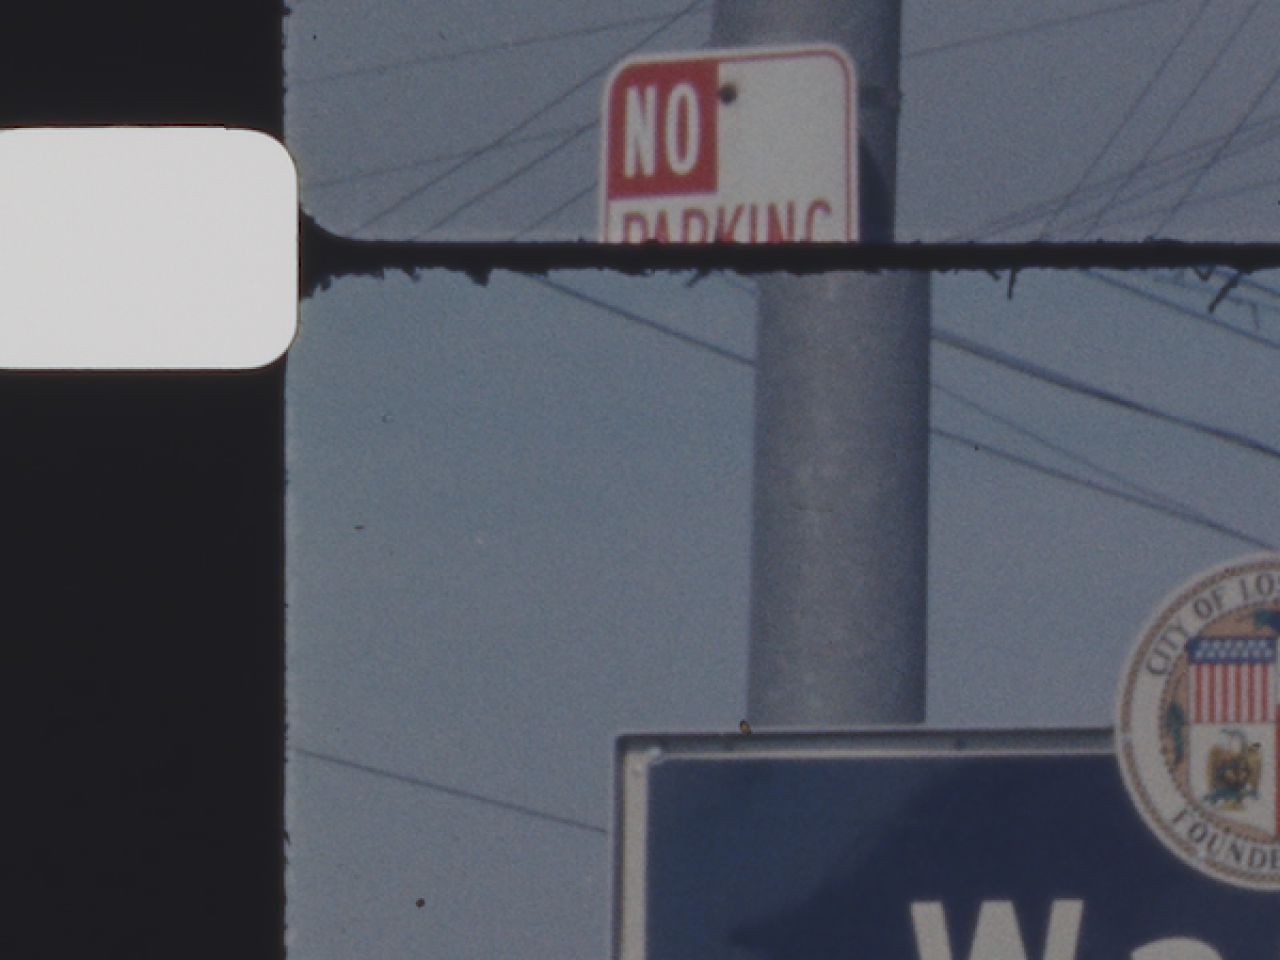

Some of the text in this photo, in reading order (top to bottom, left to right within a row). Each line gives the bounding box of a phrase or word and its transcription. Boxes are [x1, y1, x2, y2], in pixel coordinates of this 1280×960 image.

[624, 82, 700, 179] NO
[1147, 620, 1190, 676] CITY
[1194, 589, 1226, 618] OF
